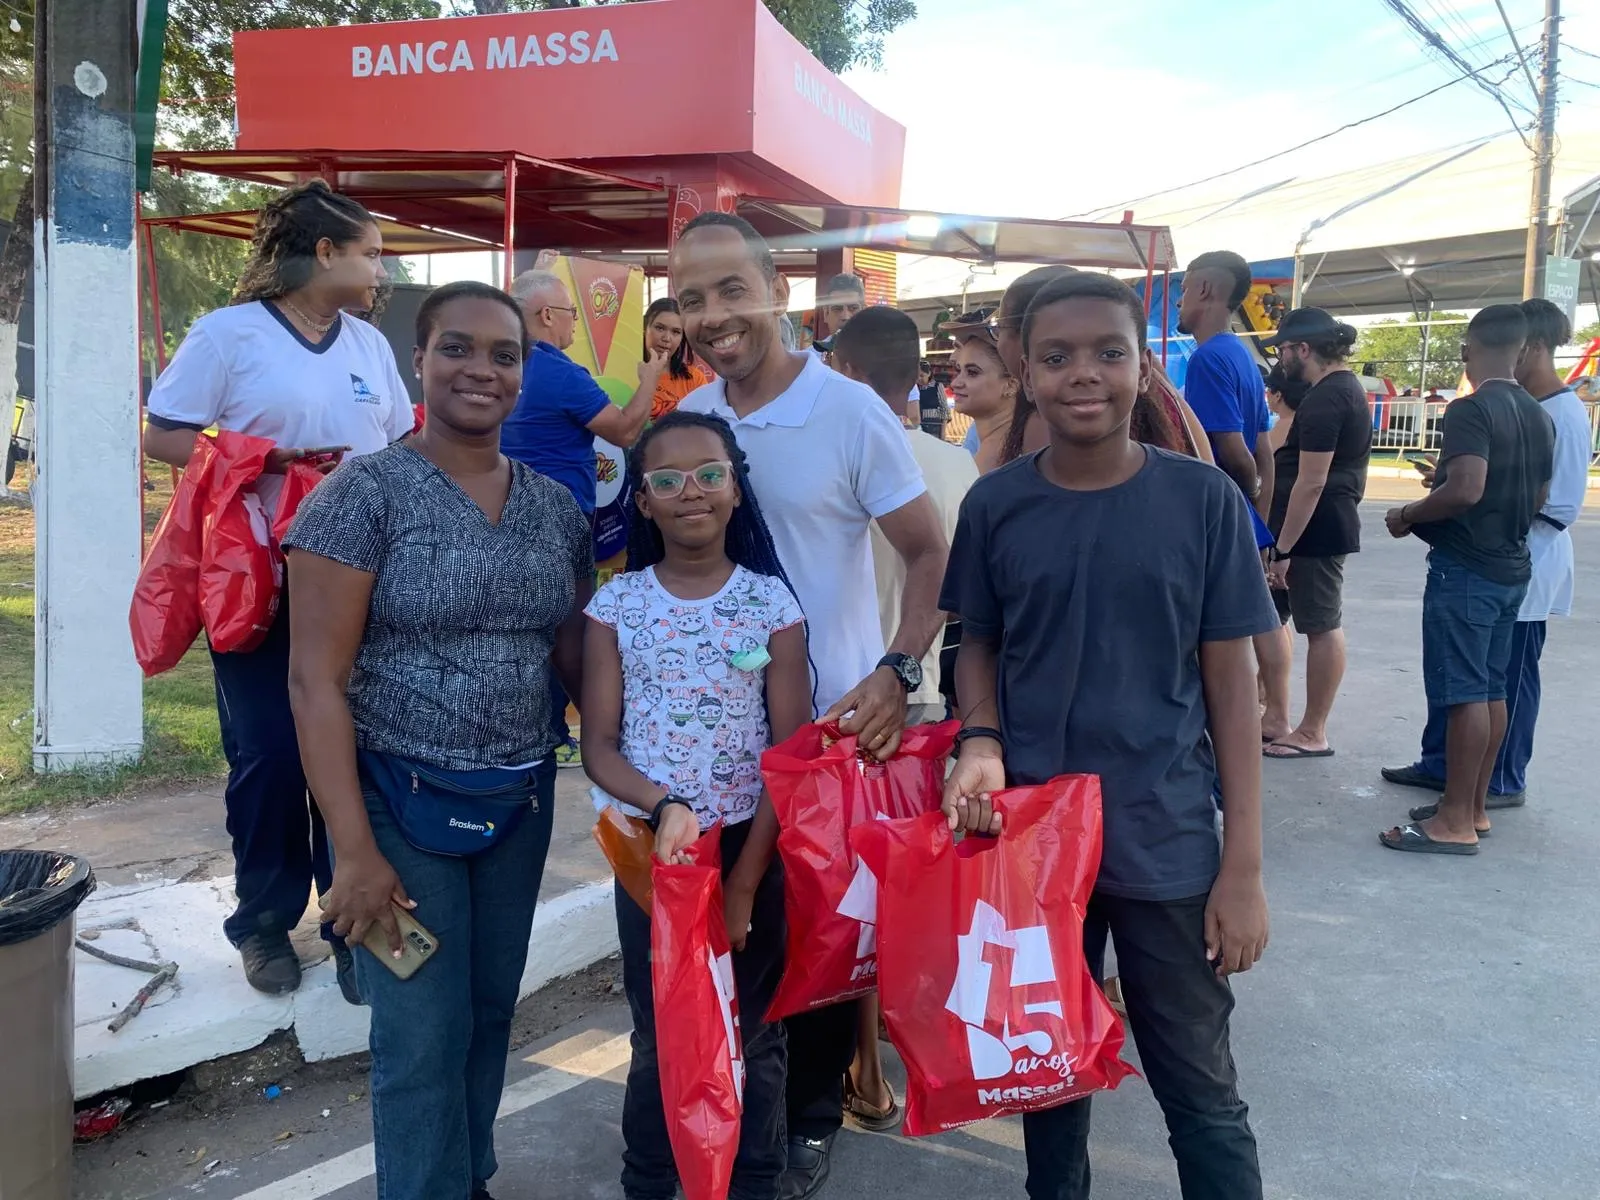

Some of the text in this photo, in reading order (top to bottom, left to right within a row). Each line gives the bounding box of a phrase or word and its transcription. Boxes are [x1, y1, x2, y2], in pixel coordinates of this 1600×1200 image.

[352, 29, 619, 77] BANCA MASSA
[1014, 1051, 1079, 1077] anos
[978, 1075, 1075, 1105] Massa!
